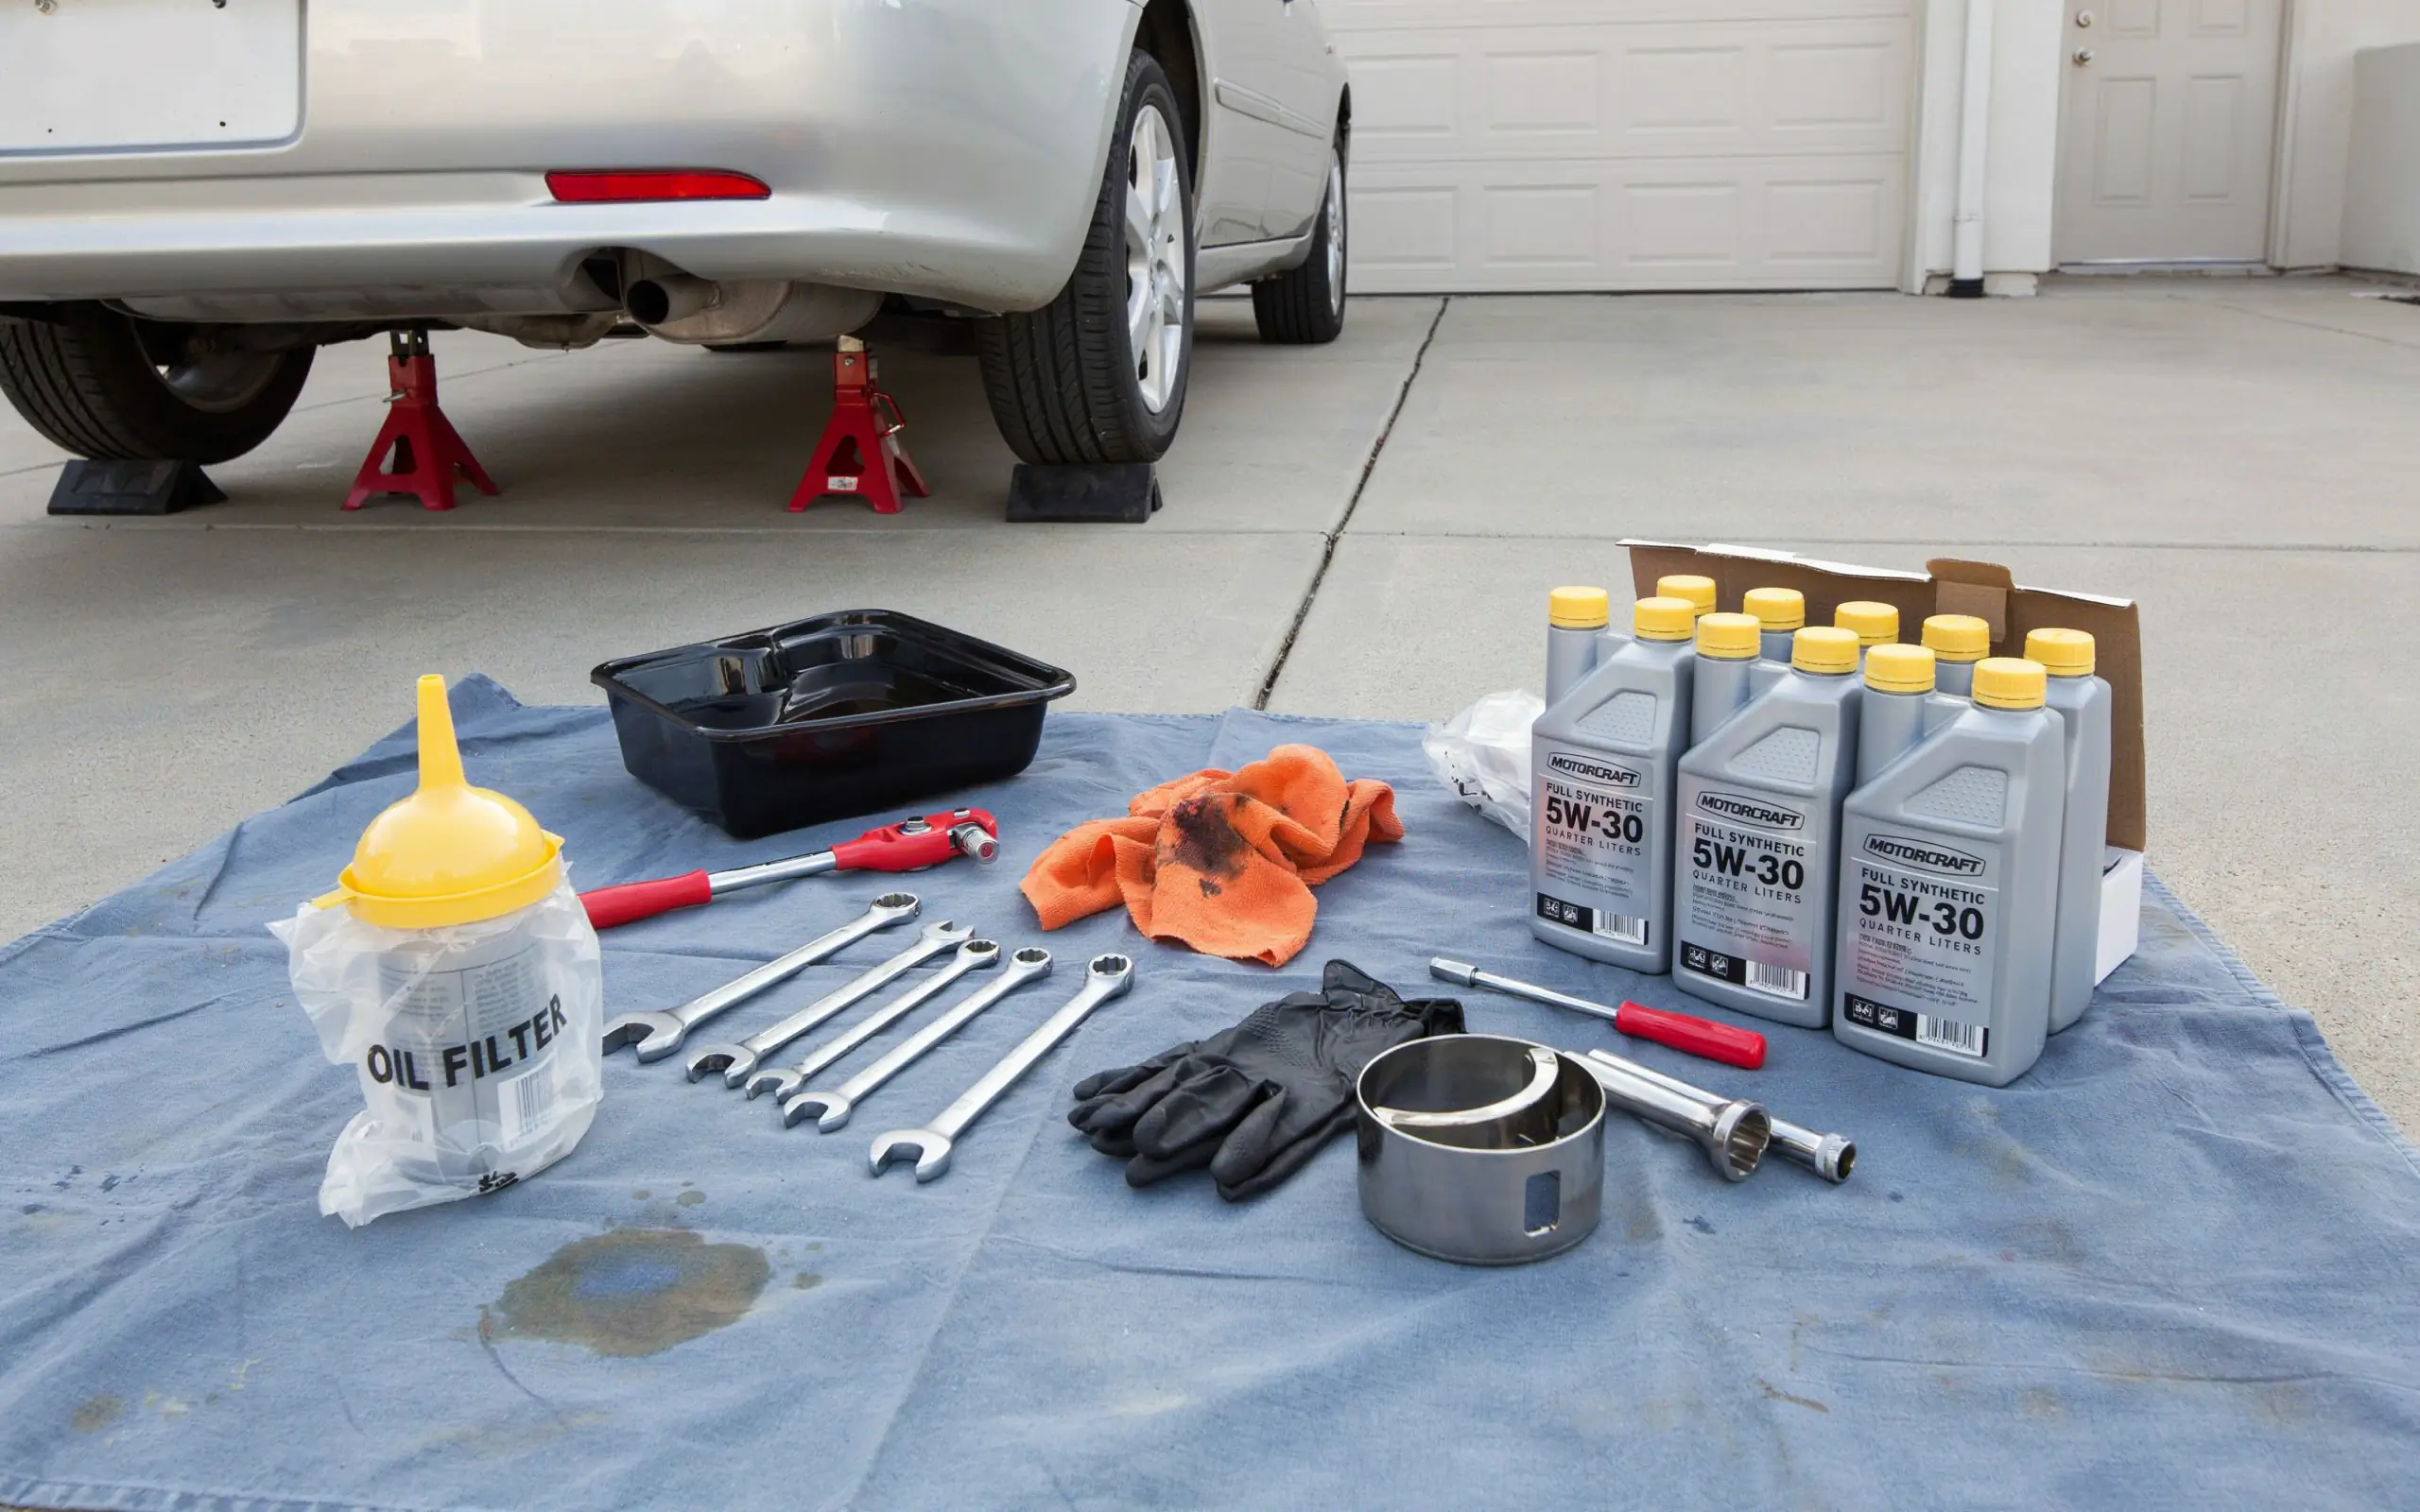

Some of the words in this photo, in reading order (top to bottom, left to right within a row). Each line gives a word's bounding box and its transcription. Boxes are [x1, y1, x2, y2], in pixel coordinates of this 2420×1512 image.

[1551, 756, 1637, 784] MOTORCRAFT
[1547, 782, 1573, 799] FULL
[1576, 790, 1643, 813] SYNTHETIC
[1701, 795, 1800, 827] MOTORCRAFT
[1547, 796, 1643, 843] 5W-30
[1546, 825, 1594, 846] QUARTER
[1599, 840, 1641, 856] LITERS
[1694, 822, 1724, 840] FULL
[1729, 832, 1805, 857] SYNTHETIC
[1868, 837, 1981, 873] MOTORCRAFT
[1693, 836, 1805, 890] 5W-30
[1692, 869, 1748, 892] QUARTER
[1754, 886, 1802, 904] LITERS
[1861, 868, 1895, 886] FULL
[1901, 878, 1985, 905] SYNTHETIC
[1859, 883, 1984, 940] 5W-30
[1859, 918, 1922, 943] QUARTER
[1929, 936, 1982, 955] LITERS
[367, 1044, 429, 1091] OIL
[442, 993, 567, 1089] FILTER
